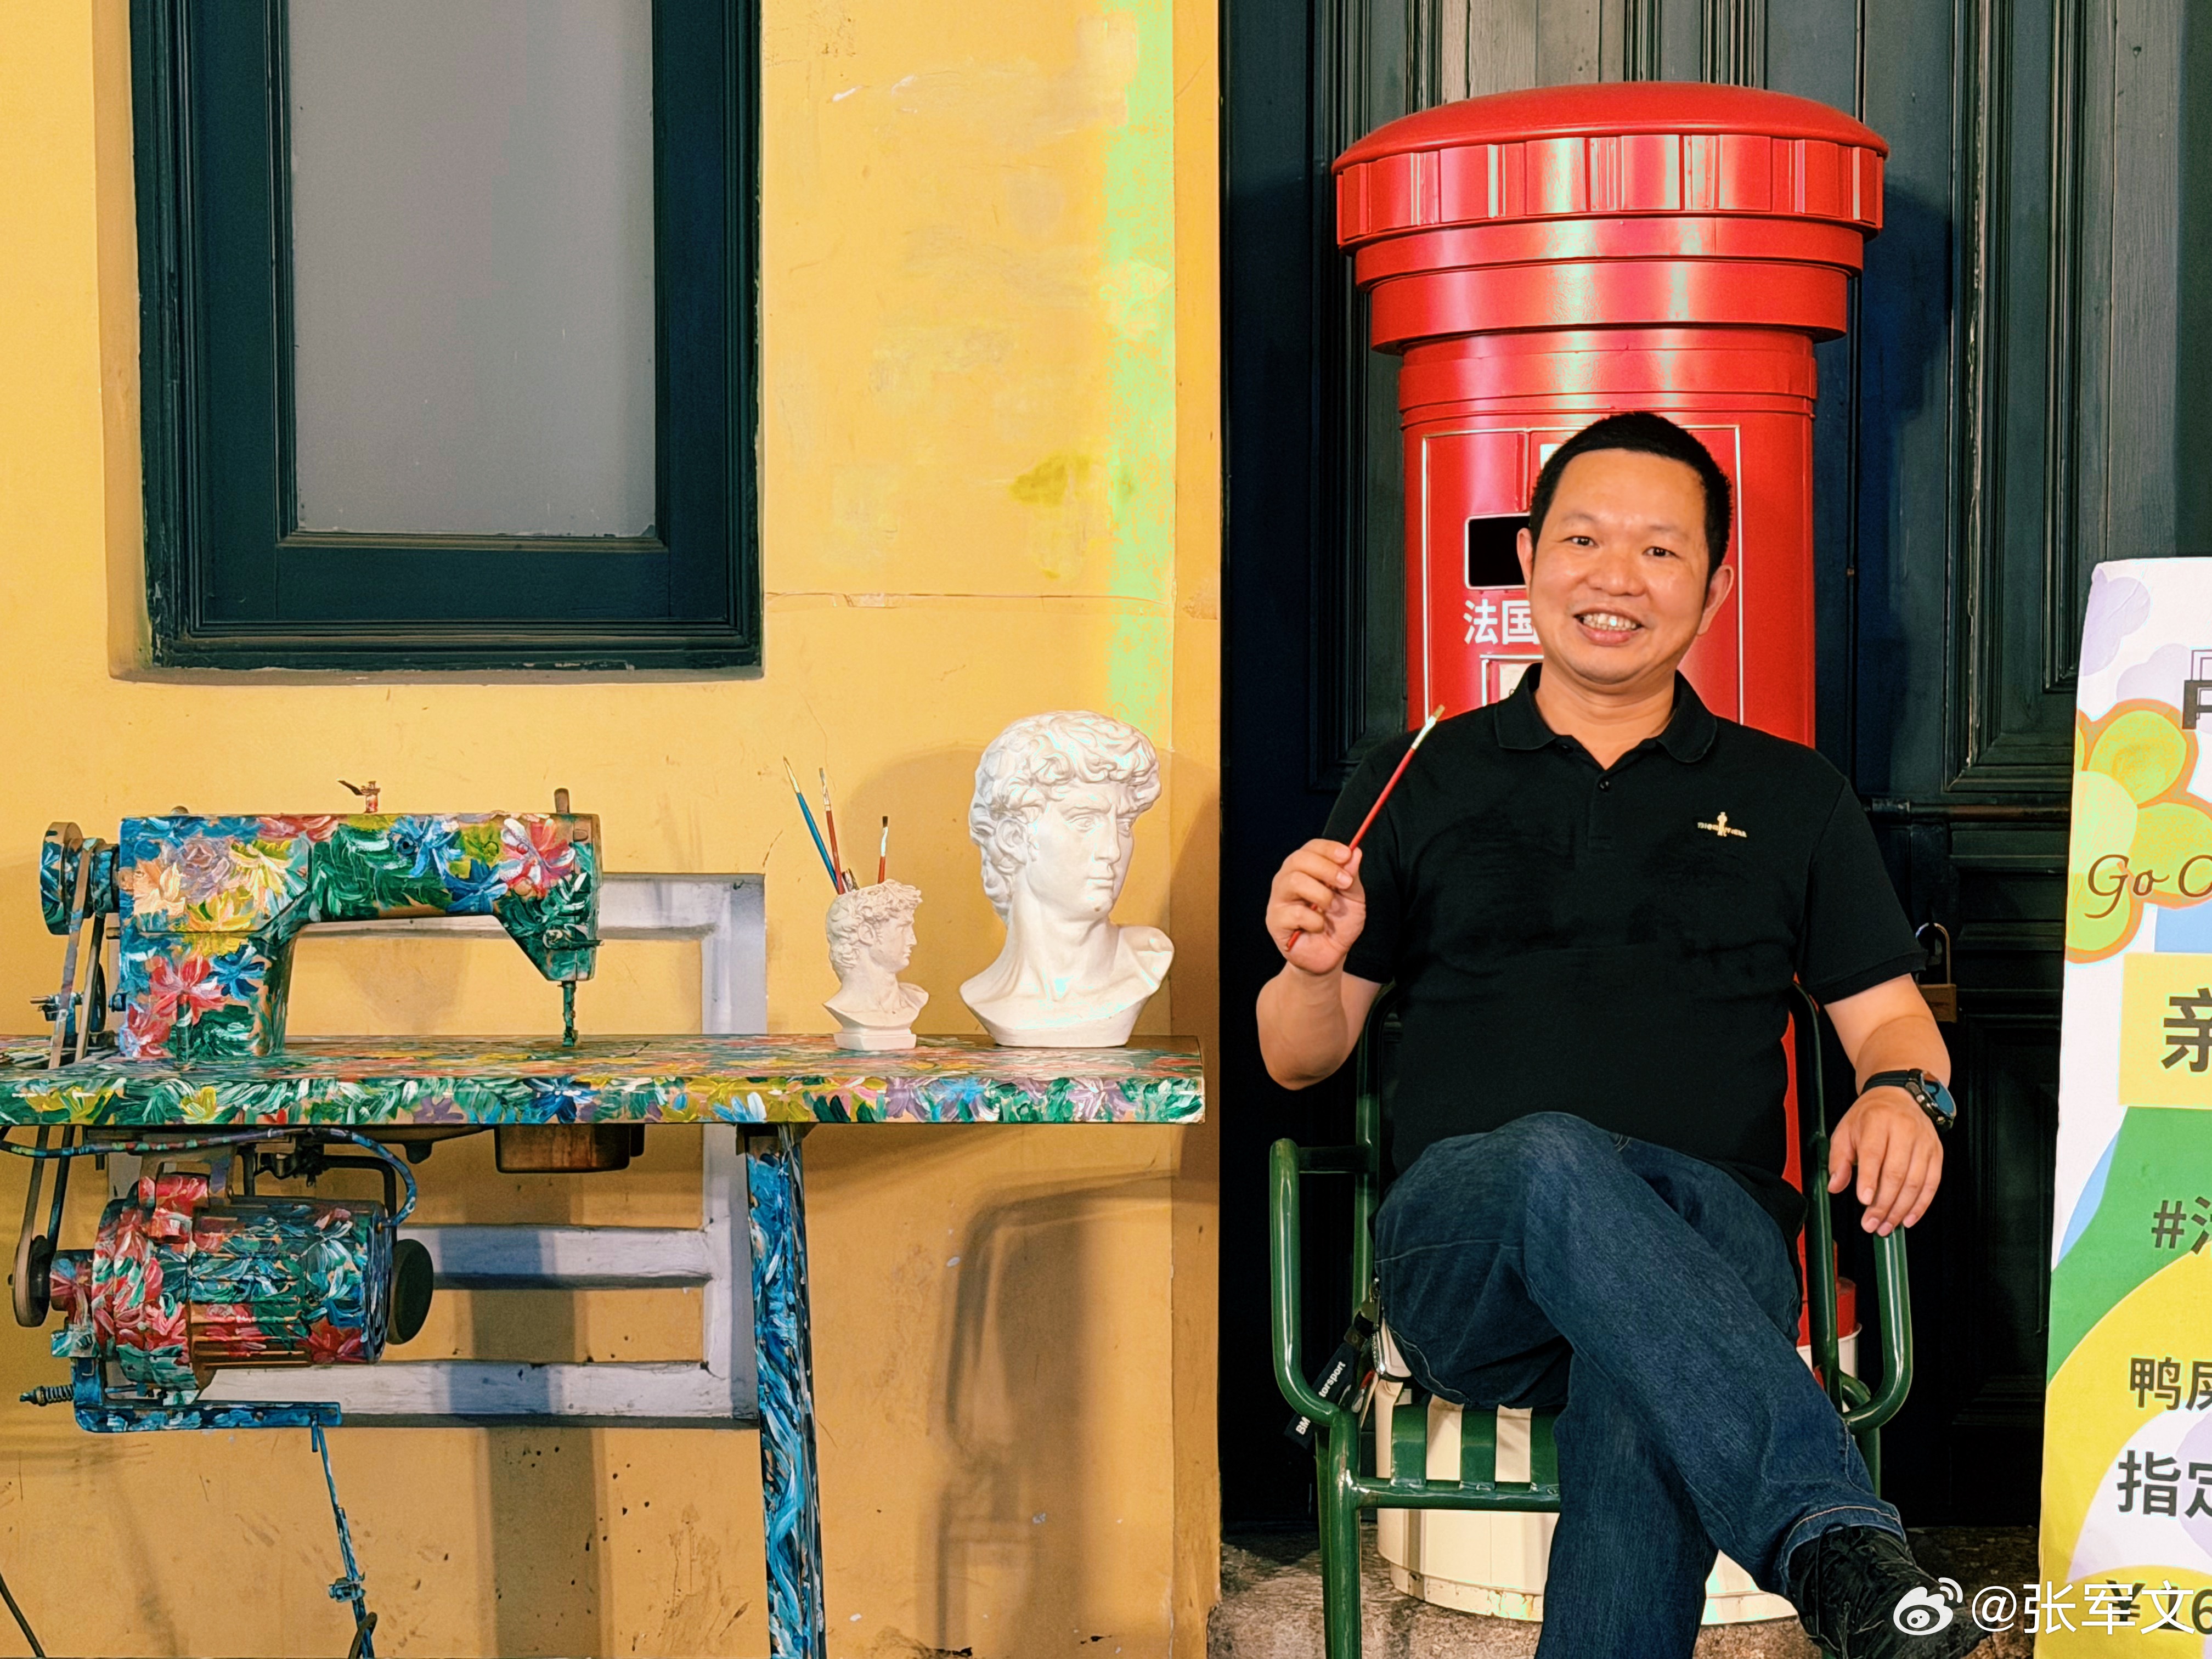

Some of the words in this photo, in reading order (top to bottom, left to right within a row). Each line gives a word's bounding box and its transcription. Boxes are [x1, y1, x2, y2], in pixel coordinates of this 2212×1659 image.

[1463, 599, 1541, 645] 法国
[2084, 854, 2170, 918] Go
[1296, 1417, 1311, 1435] BM
[1318, 1361, 1346, 1397] torsport
